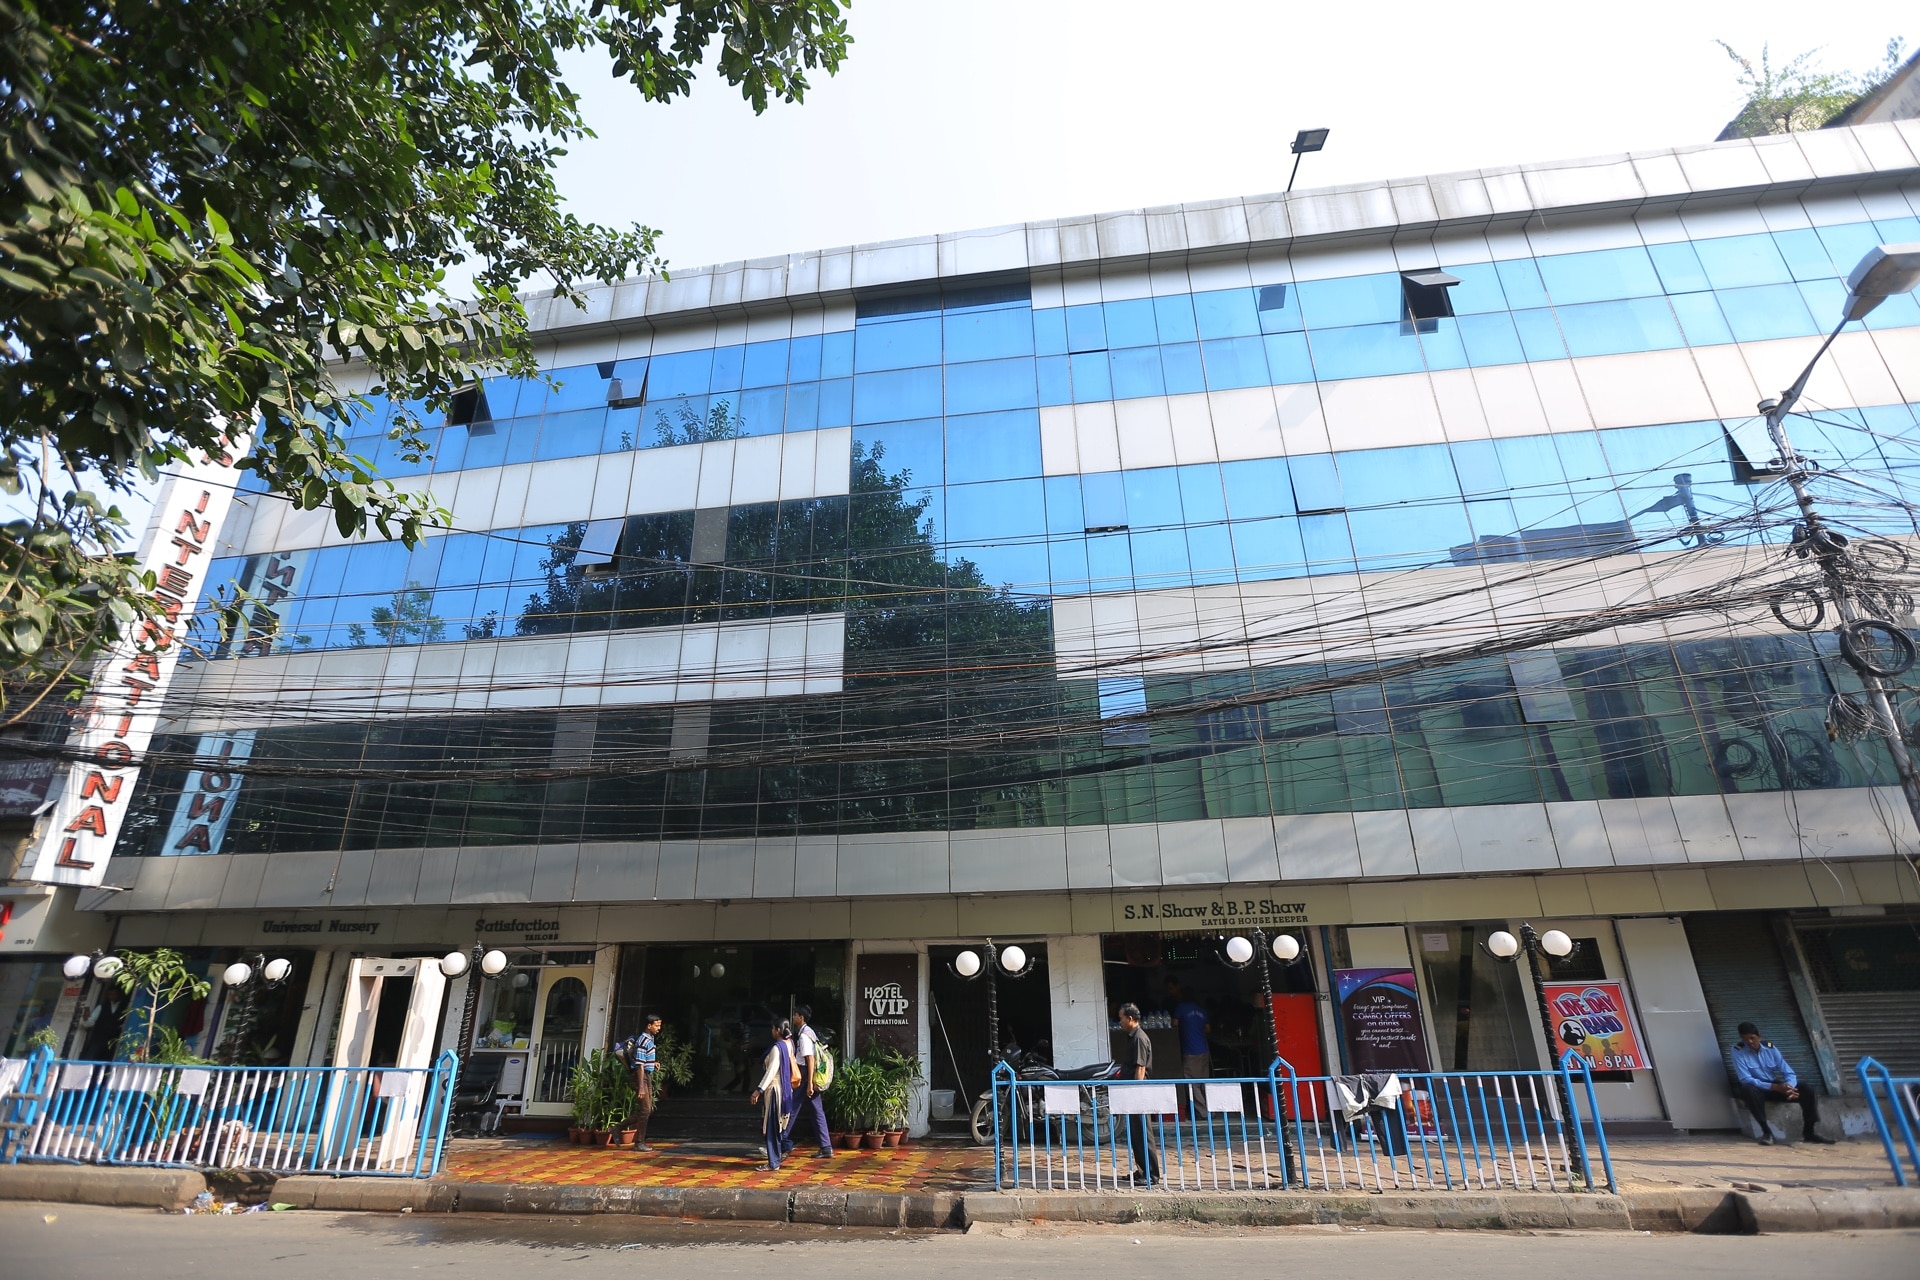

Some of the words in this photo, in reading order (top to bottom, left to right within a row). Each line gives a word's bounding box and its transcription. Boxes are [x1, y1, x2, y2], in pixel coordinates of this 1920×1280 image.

[55, 490, 211, 870] INTERNATIONAL
[1162, 903, 1207, 918] Shaw
[1211, 902, 1224, 916] &
[1260, 900, 1306, 915] Shaw
[262, 920, 322, 933] Universal
[328, 920, 380, 935] Nursery
[475, 919, 560, 932] Satisfaction
[1201, 918, 1236, 926] EATING
[1238, 917, 1270, 925] HOUSE
[1272, 916, 1308, 924] KEEPER
[864, 987, 903, 998] HOTEL
[874, 999, 909, 1015] VIP
[1552, 998, 1590, 1017] LIVE
[1584, 995, 1618, 1013] DAY
[1580, 1015, 1624, 1035] BAND
[1604, 1055, 1613, 1068] 8
